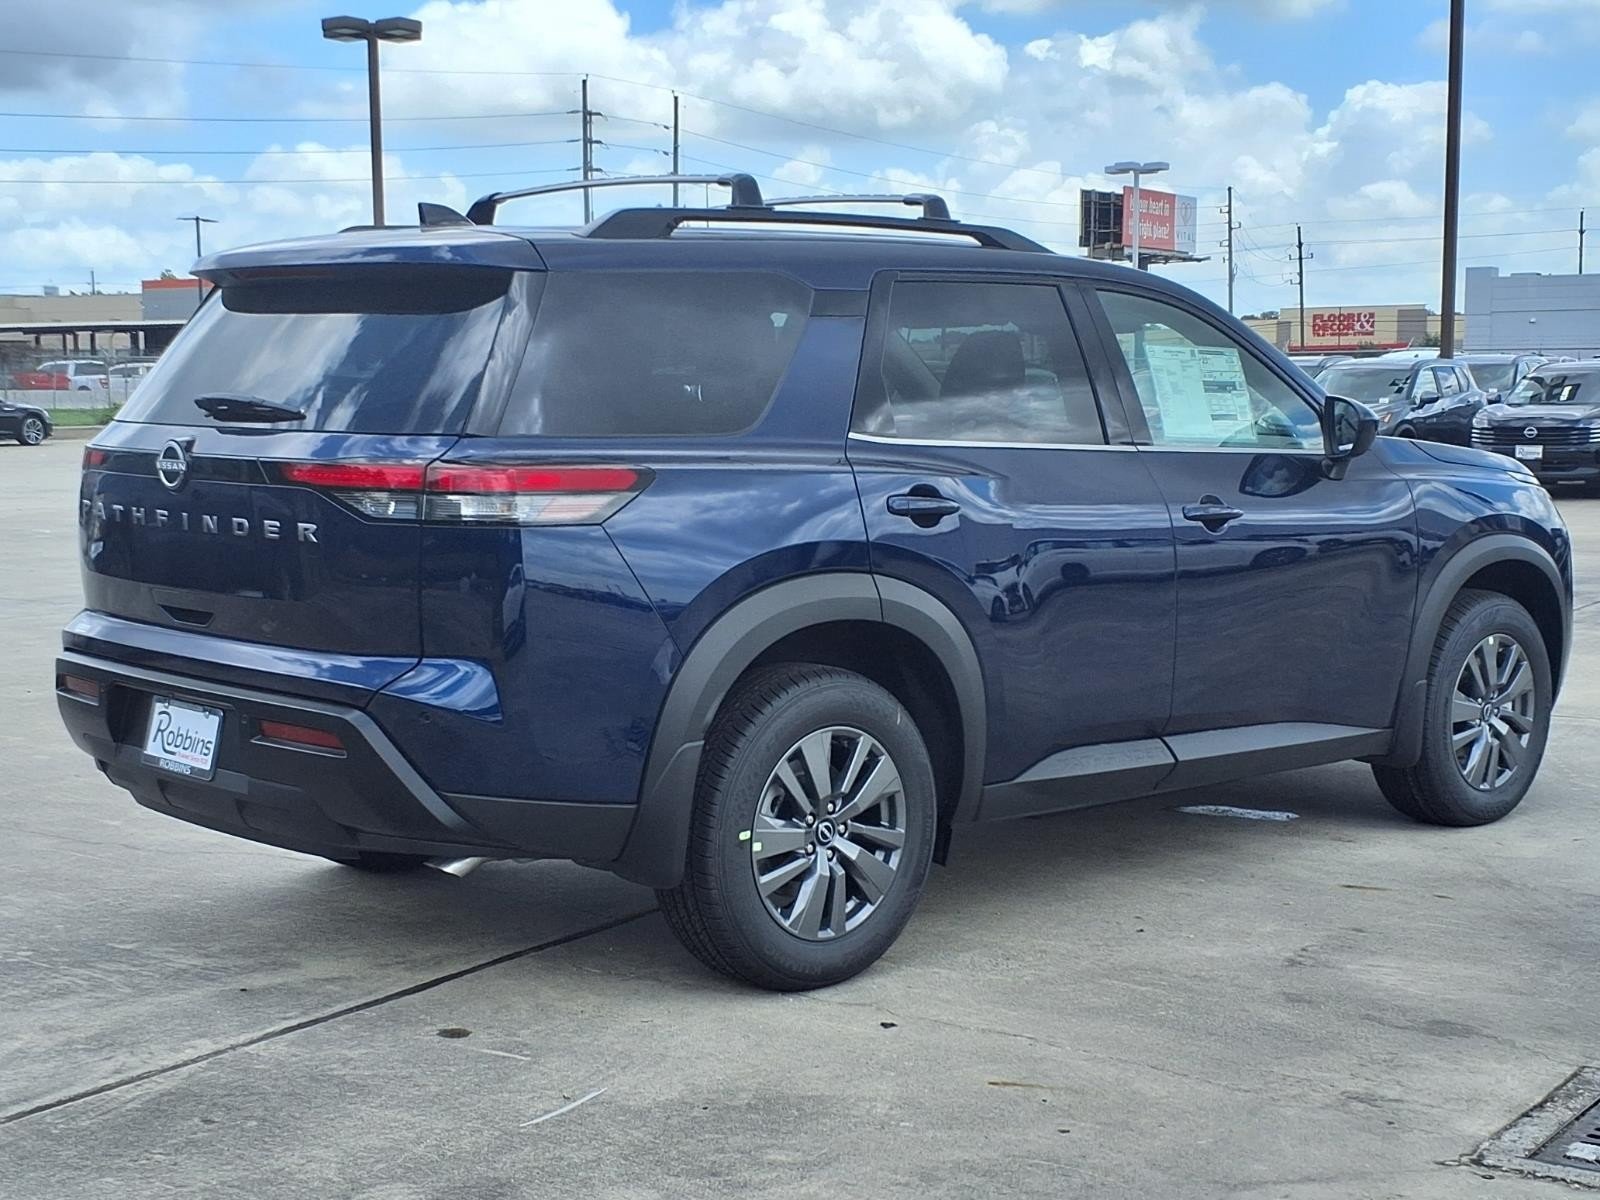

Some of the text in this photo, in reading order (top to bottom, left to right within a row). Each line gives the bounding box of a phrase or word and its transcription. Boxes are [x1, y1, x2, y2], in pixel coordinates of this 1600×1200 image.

[1149, 196, 1163, 216] heart
[1164, 199, 1170, 217] in
[1139, 219, 1152, 239] right
[1153, 221, 1169, 240] place?
[1312, 313, 1355, 323] FLOOR
[1312, 322, 1355, 332] DECOR
[157, 461, 186, 470] SSAN
[80, 499, 319, 543] PATHFINDER
[152, 710, 213, 757] Robbins
[159, 758, 191, 775] ROBBINS
